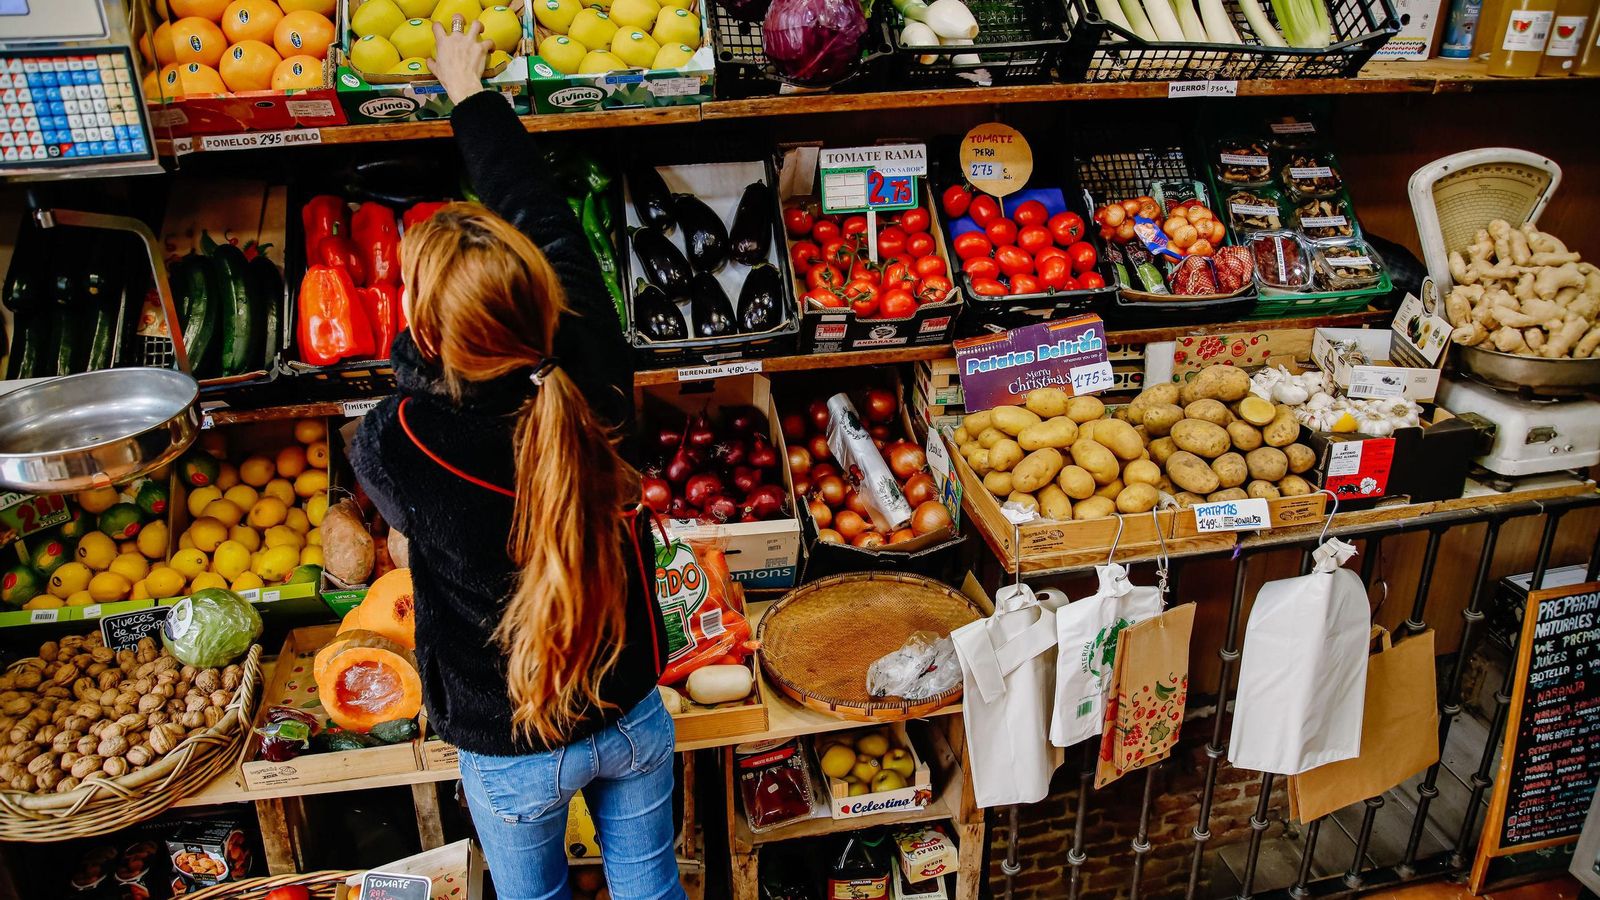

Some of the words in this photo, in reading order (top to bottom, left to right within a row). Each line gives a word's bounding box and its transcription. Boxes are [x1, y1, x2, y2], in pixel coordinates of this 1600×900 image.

[1171, 84, 1206, 92] PUERROS
[555, 91, 600, 106] Livinda
[365, 101, 411, 117] Livinda
[206, 137, 257, 149] POMELOS
[969, 133, 1014, 144] TOMATE
[826, 151, 881, 164] TOMATE
[884, 148, 924, 161] RAMA
[972, 147, 995, 157] PERA
[966, 350, 1035, 375] Patatas
[679, 367, 723, 377] BERENJENA
[1008, 372, 1072, 396] Christmas
[1196, 503, 1238, 517] PATATAS
[113, 628, 129, 638] de
[1534, 614, 1594, 639] NATURALES
[1534, 640, 1556, 655] WE
[1576, 647, 1590, 657] AT
[1081, 640, 1093, 674] MATERIAL
[1530, 666, 1570, 684] BOTELLA
[1537, 681, 1585, 703] NARANJA
[1537, 696, 1567, 708] ORANGE
[1536, 728, 1577, 743] PINEAPPLE
[851, 796, 911, 814] Celestino
[368, 878, 411, 889] TOMATE
